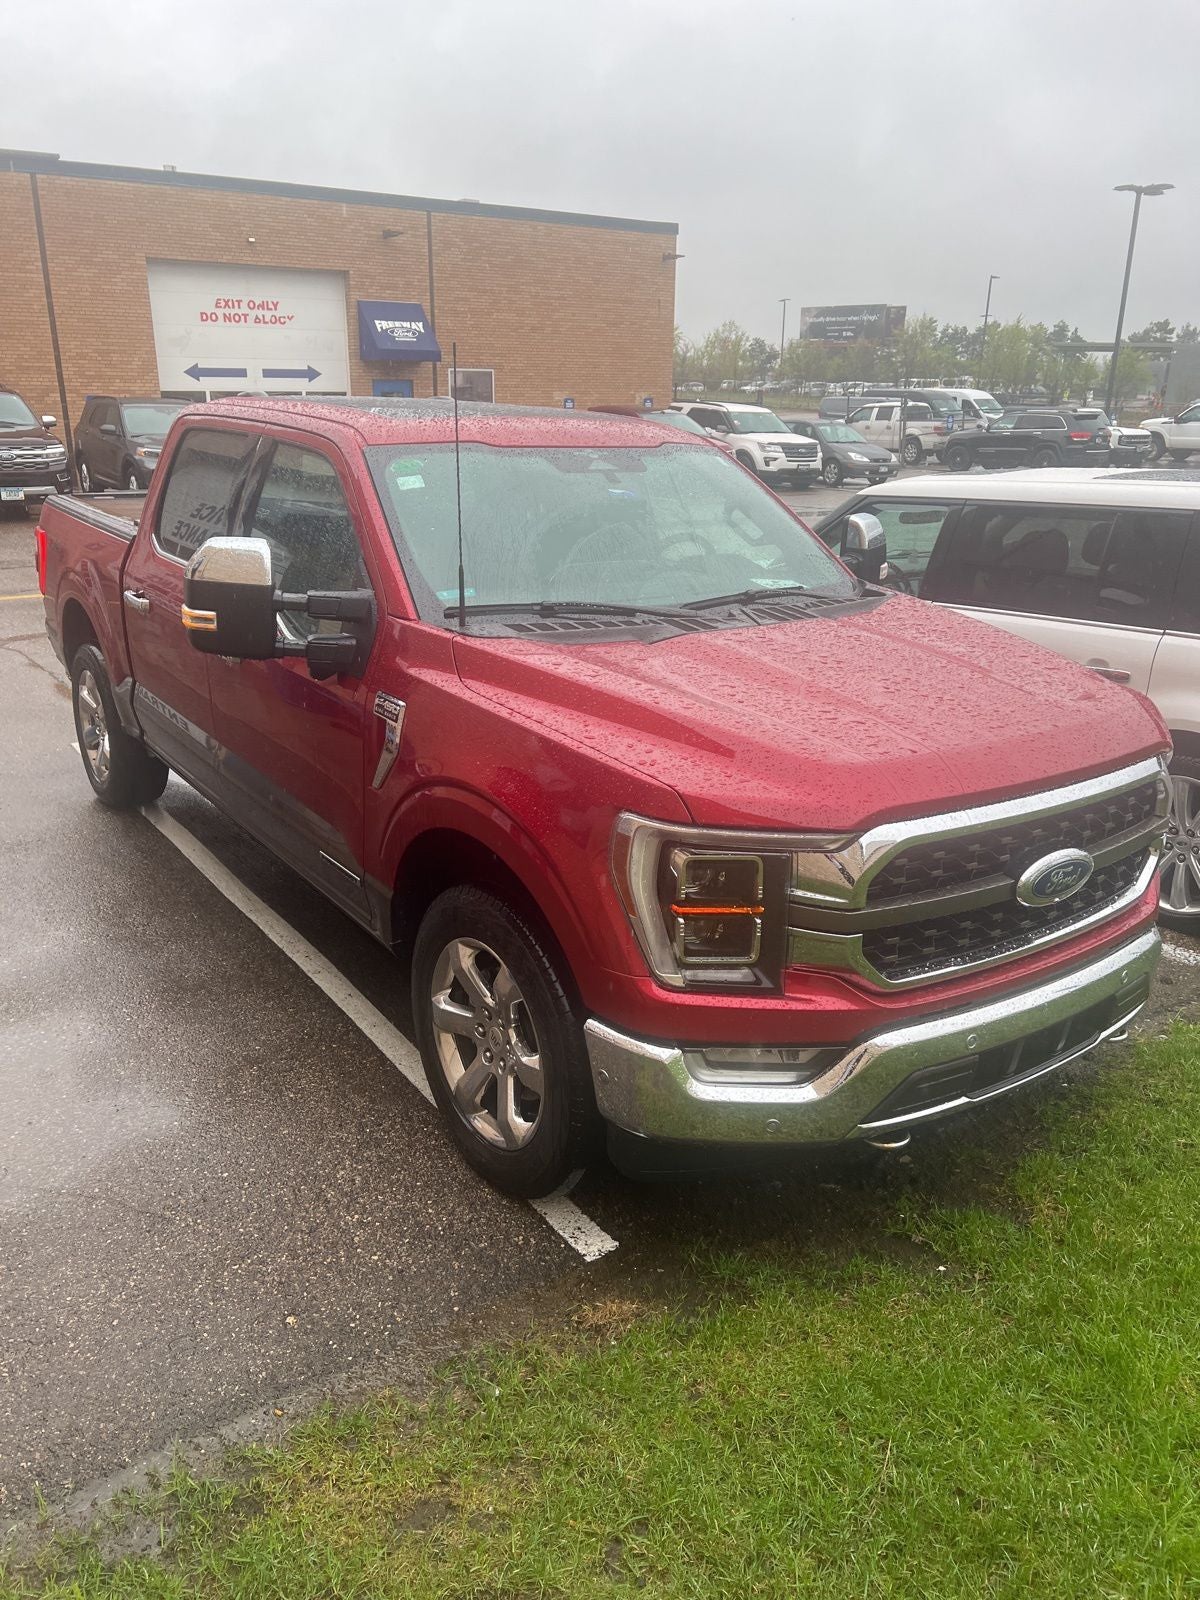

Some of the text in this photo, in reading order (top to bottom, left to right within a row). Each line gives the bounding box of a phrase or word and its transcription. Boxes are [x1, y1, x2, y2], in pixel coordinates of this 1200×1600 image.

[215, 298, 279, 311] EXIT ONLY
[200, 312, 219, 322] DO
[223, 313, 249, 324] NOT
[374, 319, 425, 333] FREEWAY
[1045, 866, 1082, 894] Ford
